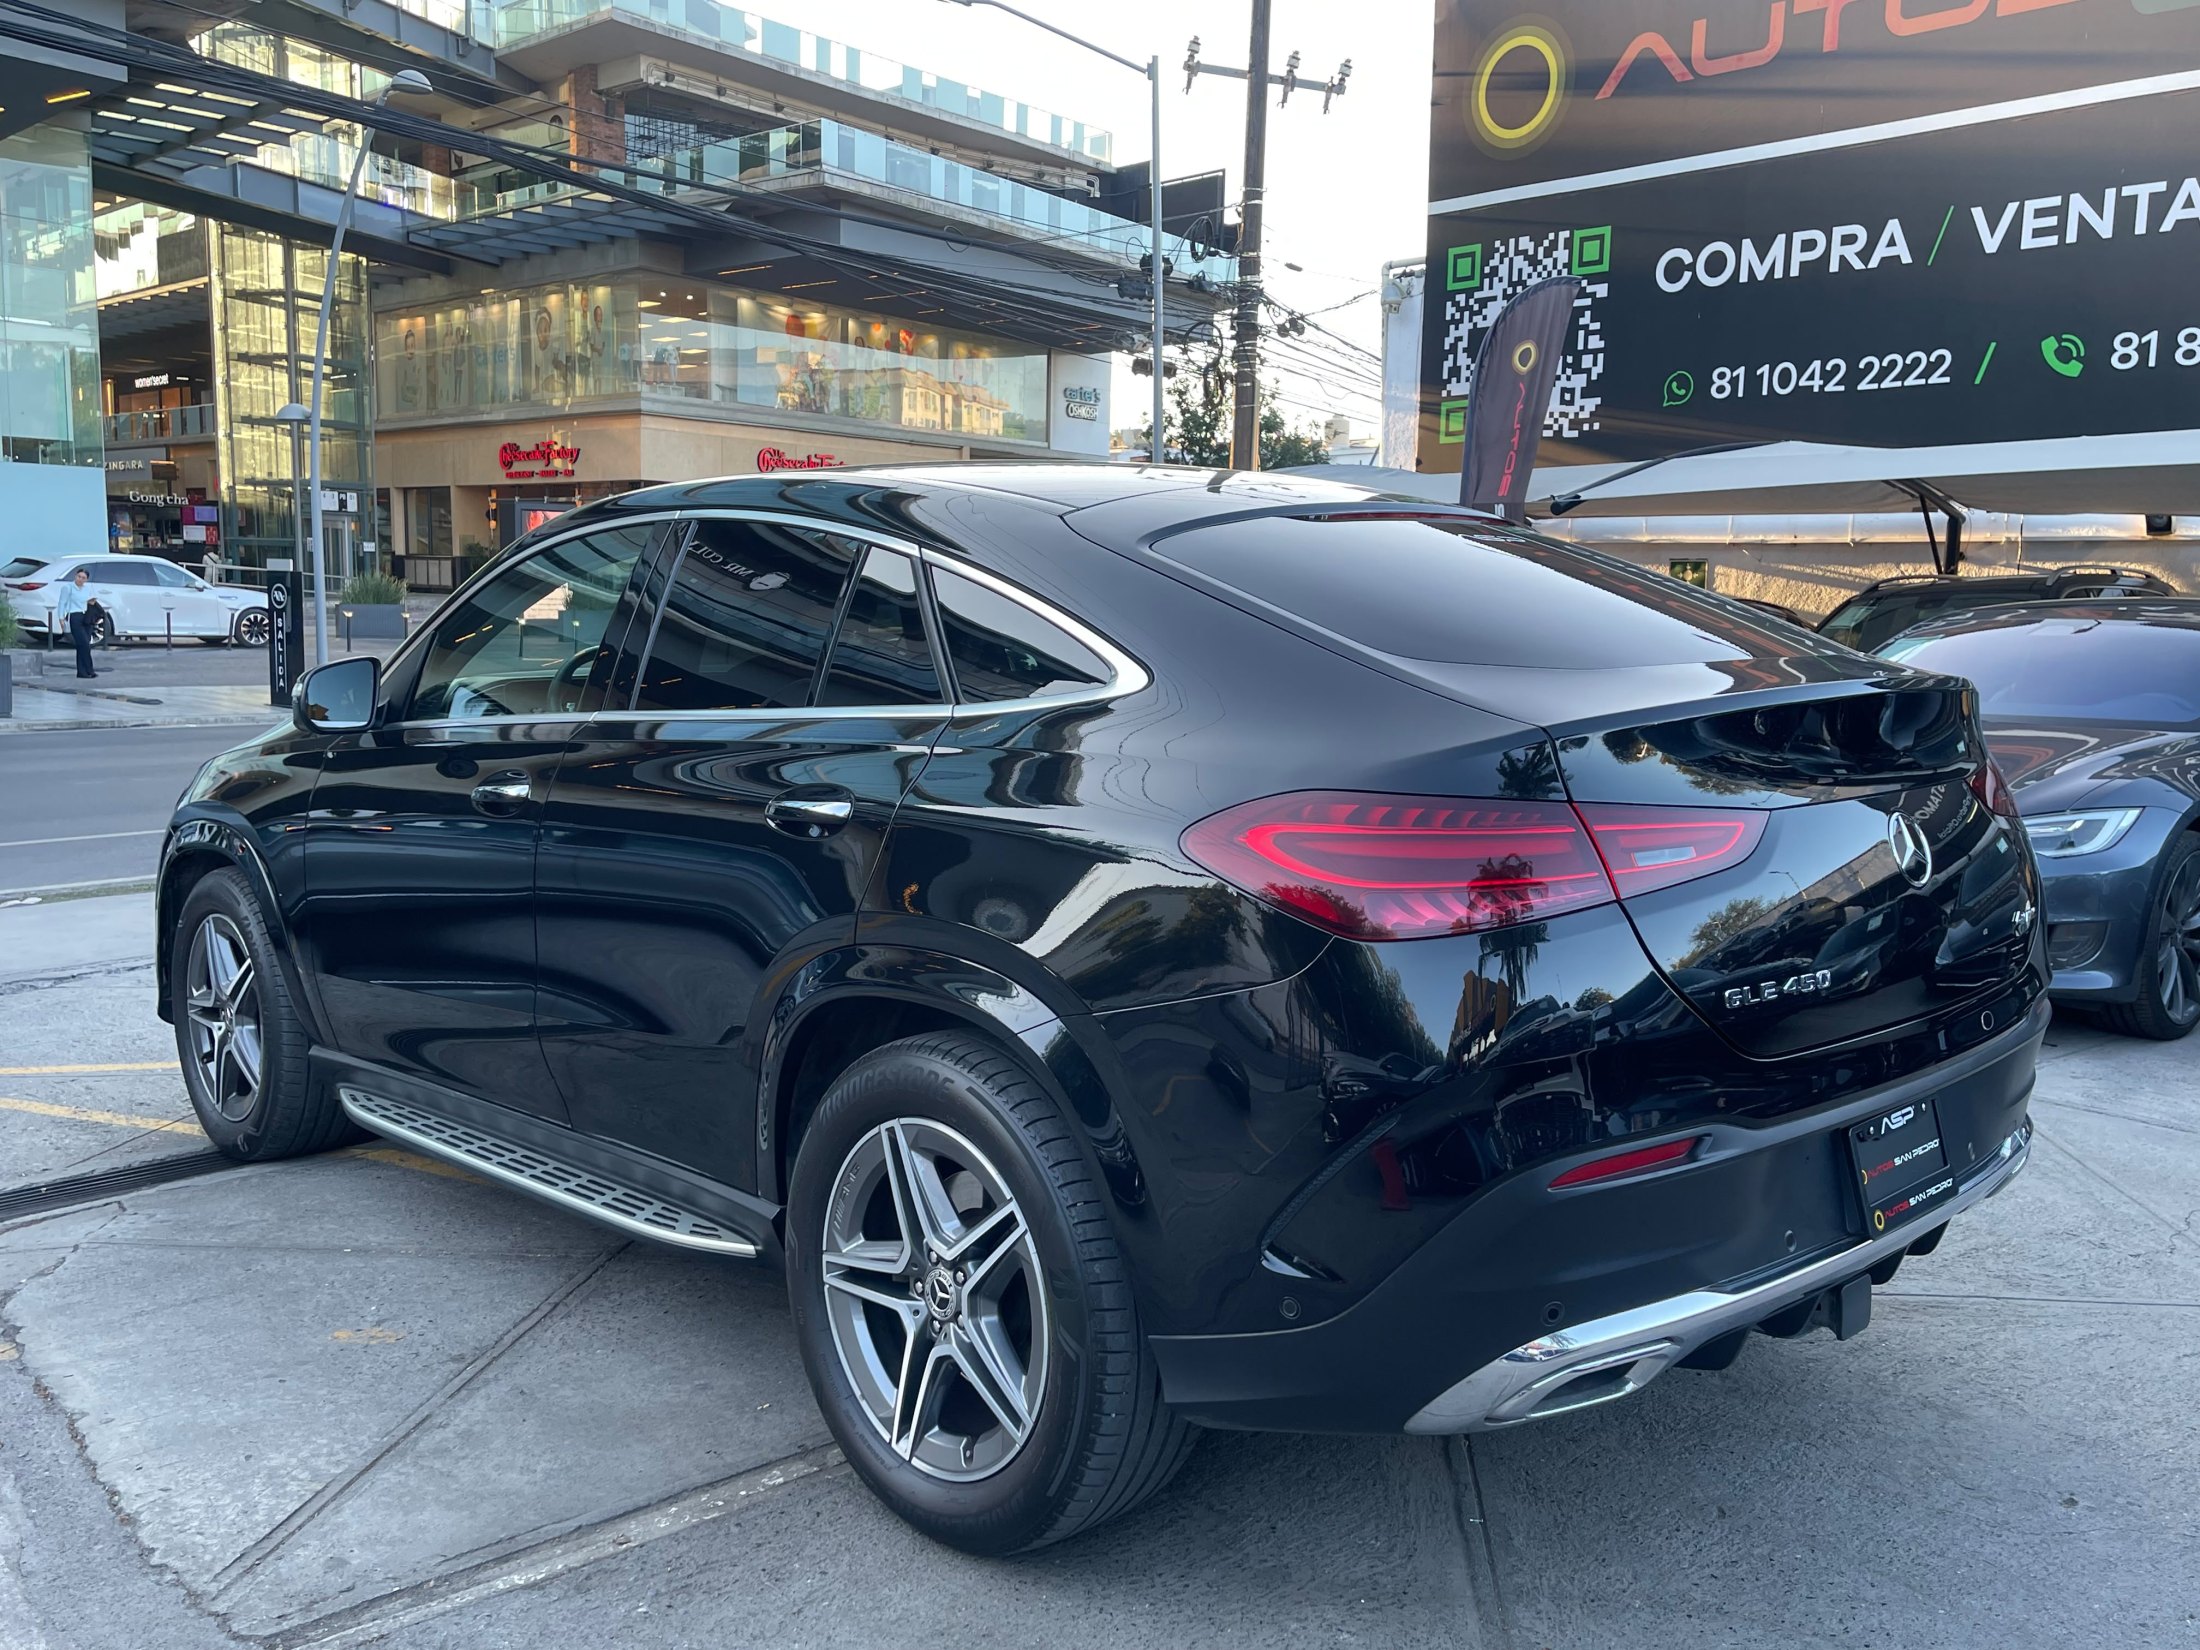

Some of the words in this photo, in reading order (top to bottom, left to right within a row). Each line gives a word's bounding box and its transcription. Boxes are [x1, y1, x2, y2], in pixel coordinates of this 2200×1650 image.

[1655, 218, 1913, 292] COMPRA
[1970, 177, 2200, 254] VENTA
[1710, 365, 1747, 400] 81
[1755, 357, 1847, 397] 1042
[1857, 348, 1953, 392] 2222
[2110, 330, 2160, 371] 81
[129, 490, 165, 507] Gong
[166, 493, 190, 506] cha
[277, 617, 285, 688] SALIDA
[1724, 981, 1779, 1009] GLE
[1783, 969, 1832, 994] 450
[1881, 1105, 1915, 1135] ASP
[1893, 1151, 1913, 1166] SAN
[1912, 1138, 1940, 1158] PEDRO
[1884, 1199, 1910, 1219] AUTOS
[1908, 1191, 1927, 1207] SAN
[1926, 1177, 1954, 1199] PEDRO
